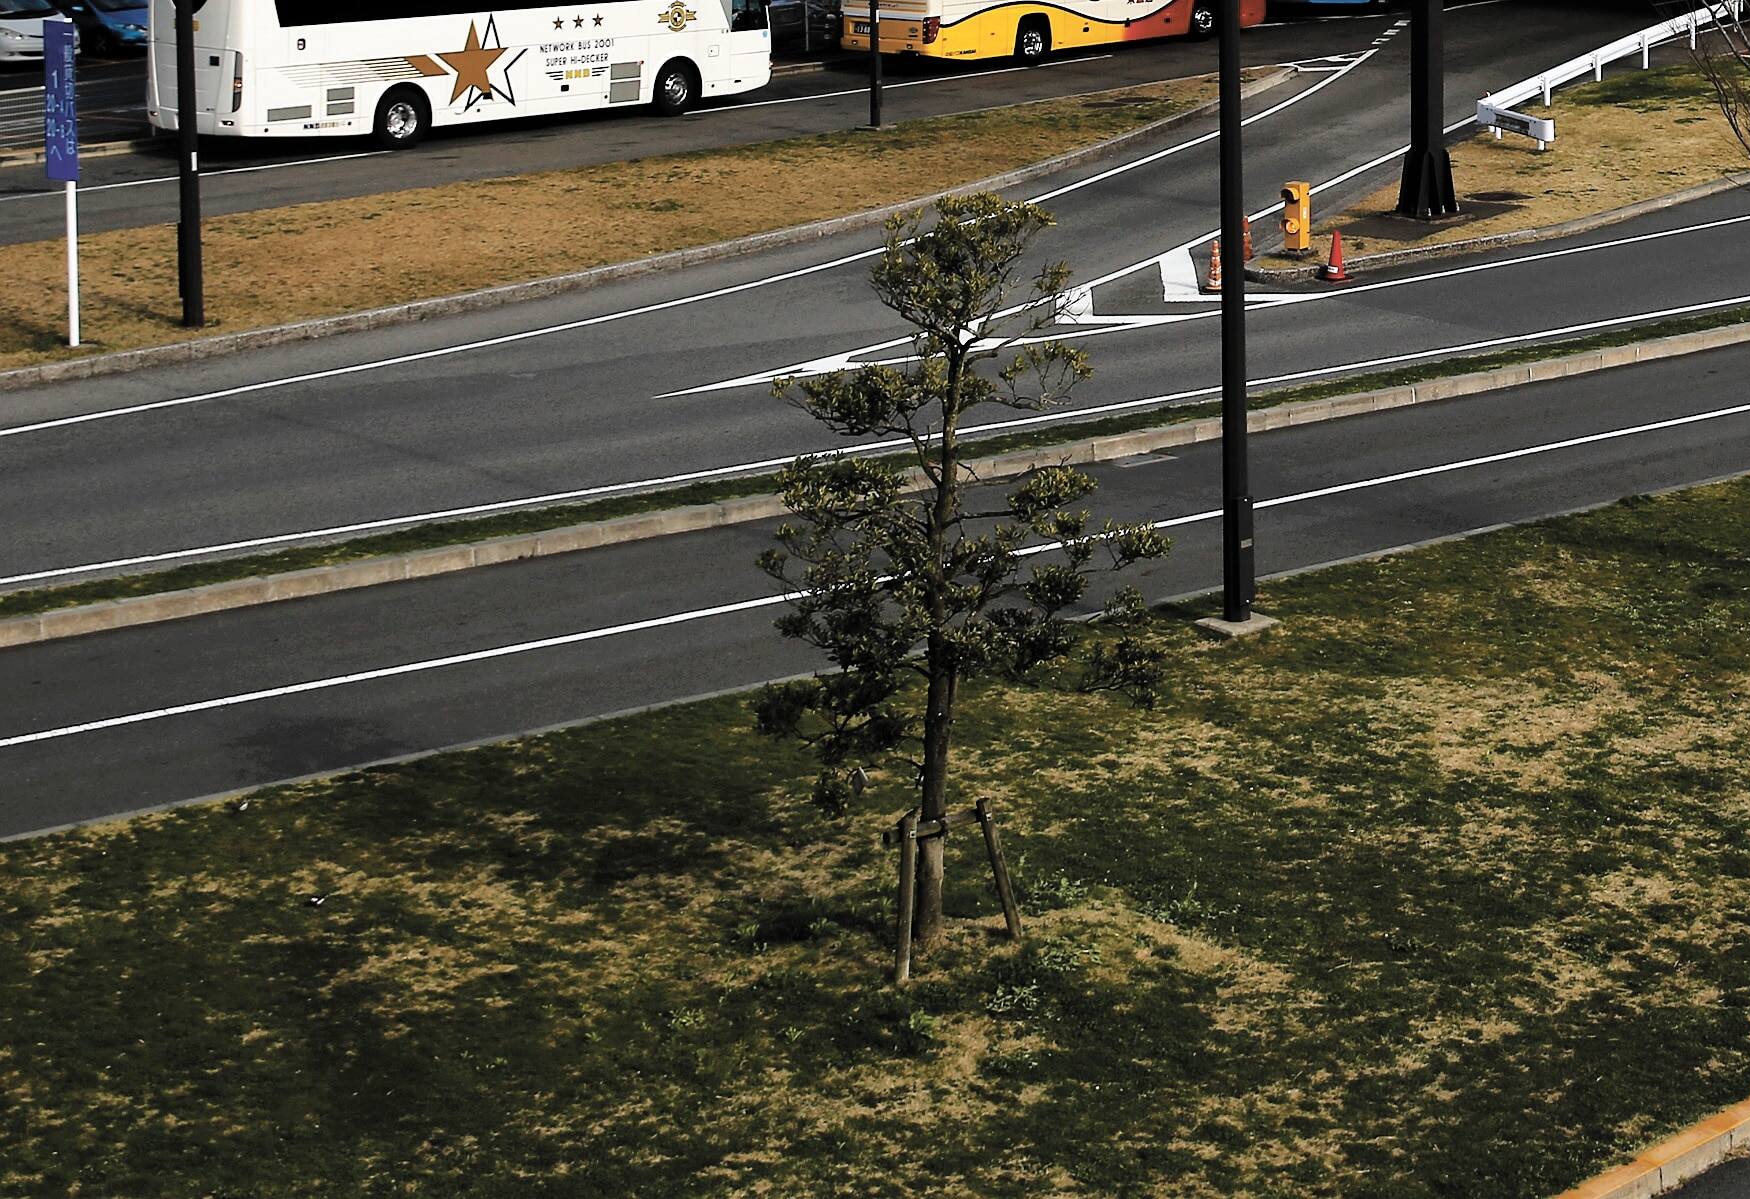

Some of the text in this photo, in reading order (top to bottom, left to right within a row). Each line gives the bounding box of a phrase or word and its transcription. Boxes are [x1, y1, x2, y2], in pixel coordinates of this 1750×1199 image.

[540, 38, 614, 53] NETWORK BUS 2001
[546, 53, 609, 67] SUPER HI-DECKER
